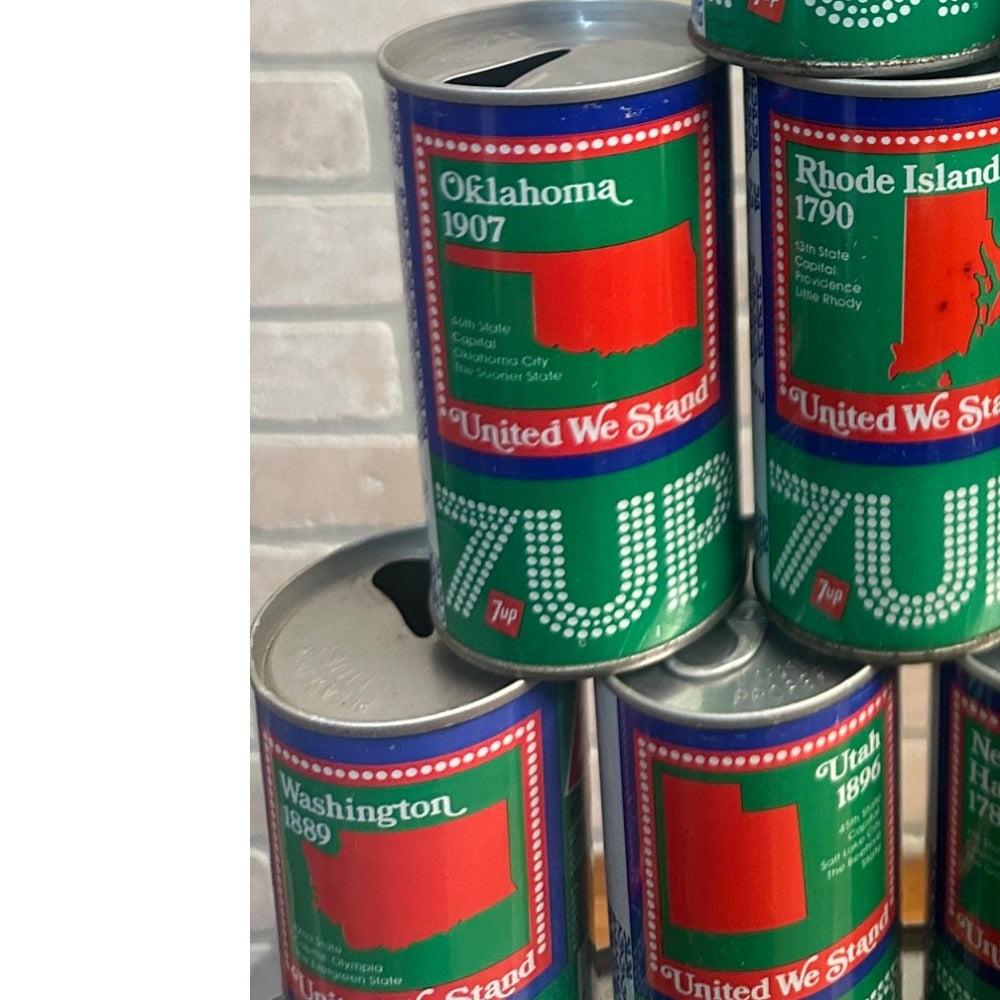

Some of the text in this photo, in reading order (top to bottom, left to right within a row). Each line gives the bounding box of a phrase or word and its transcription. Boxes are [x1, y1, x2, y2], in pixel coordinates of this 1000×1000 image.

[440, 171, 633, 206] Oklahoma
[795, 153, 1000, 198] Rhode Island
[443, 211, 505, 243] 1907
[795, 195, 854, 229] 1790
[818, 244, 850, 261] State
[794, 271, 861, 294] Providence
[822, 293, 862, 311] Rhody
[522, 356, 549, 368] City
[526, 371, 562, 381] State
[451, 376, 709, 454] United We Stand
[789, 386, 896, 436] United
[901, 392, 950, 431] We
[818, 579, 843, 605] 7up
[492, 600, 518, 622] 7up
[814, 728, 880, 782] Utah
[837, 757, 881, 808] 1896
[279, 772, 467, 828] Washington
[282, 805, 331, 845] 1889
[661, 964, 771, 1000] United
[775, 954, 820, 996] We
[825, 904, 889, 982] Stand
[369, 976, 402, 985] State
